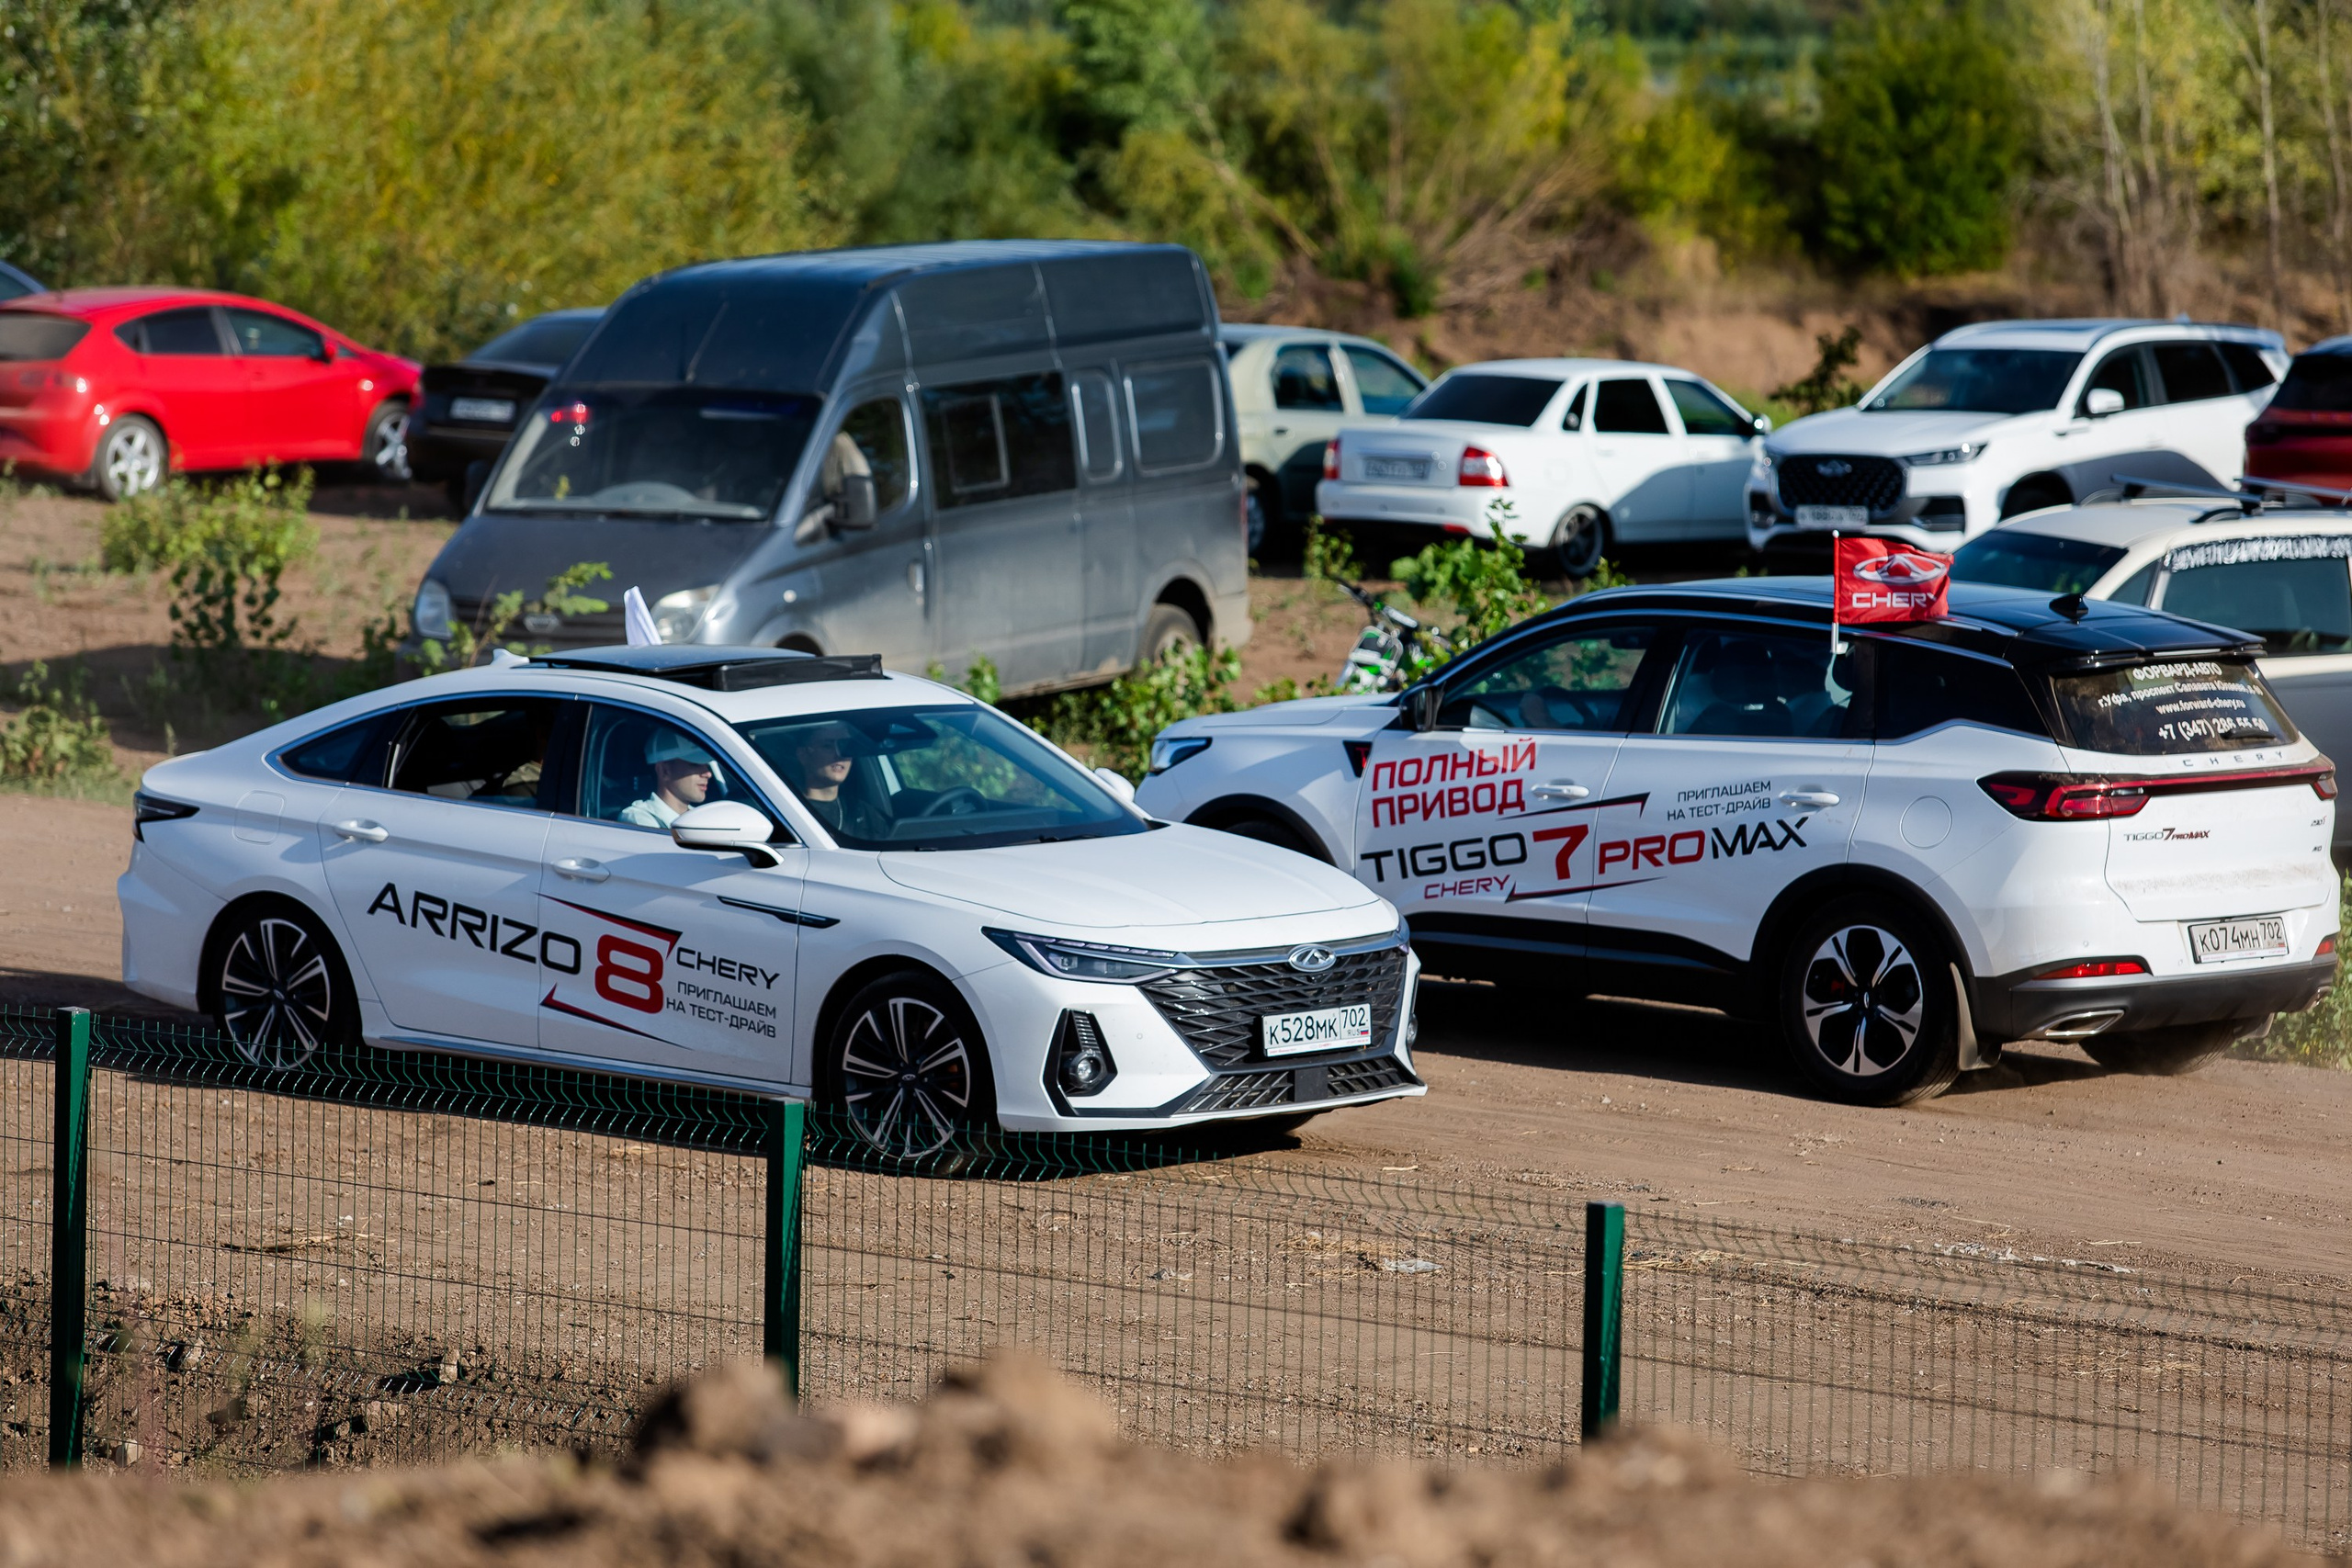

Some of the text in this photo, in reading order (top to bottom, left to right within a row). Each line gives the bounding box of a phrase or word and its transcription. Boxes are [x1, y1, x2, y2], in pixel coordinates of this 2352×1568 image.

[2132, 662, 2222, 681] ФОРВАРД-АВТО
[2132, 684, 2175, 702] проспект
[2175, 681, 2215, 694] Салавата
[2155, 697, 2246, 715] www.forward-chery.ru
[2158, 723, 2176, 740] +7
[2177, 719, 2215, 741] (347)
[1373, 738, 1536, 792] ПОЛНЫЙ
[2183, 750, 2282, 767] CHERY
[1373, 779, 1526, 829] ПРИВОД
[1678, 781, 1771, 803] ПРИГЛАШАЕМ
[1668, 796, 1771, 821] НА ТЕСТ-ДРАЙВ
[1361, 832, 1528, 883] TIGGO
[1532, 824, 1589, 881] 7
[1424, 874, 1510, 899] CHERY
[2260, 921, 2282, 941] 702
[367, 882, 663, 1014] ARRIZO 8
[676, 946, 780, 989] CHERY
[677, 981, 776, 1019] ПРИГЛАШАЕМ
[666, 997, 776, 1038] НА ТЕСТ-ДРАЙВ
[1340, 1007, 1366, 1029] 702
